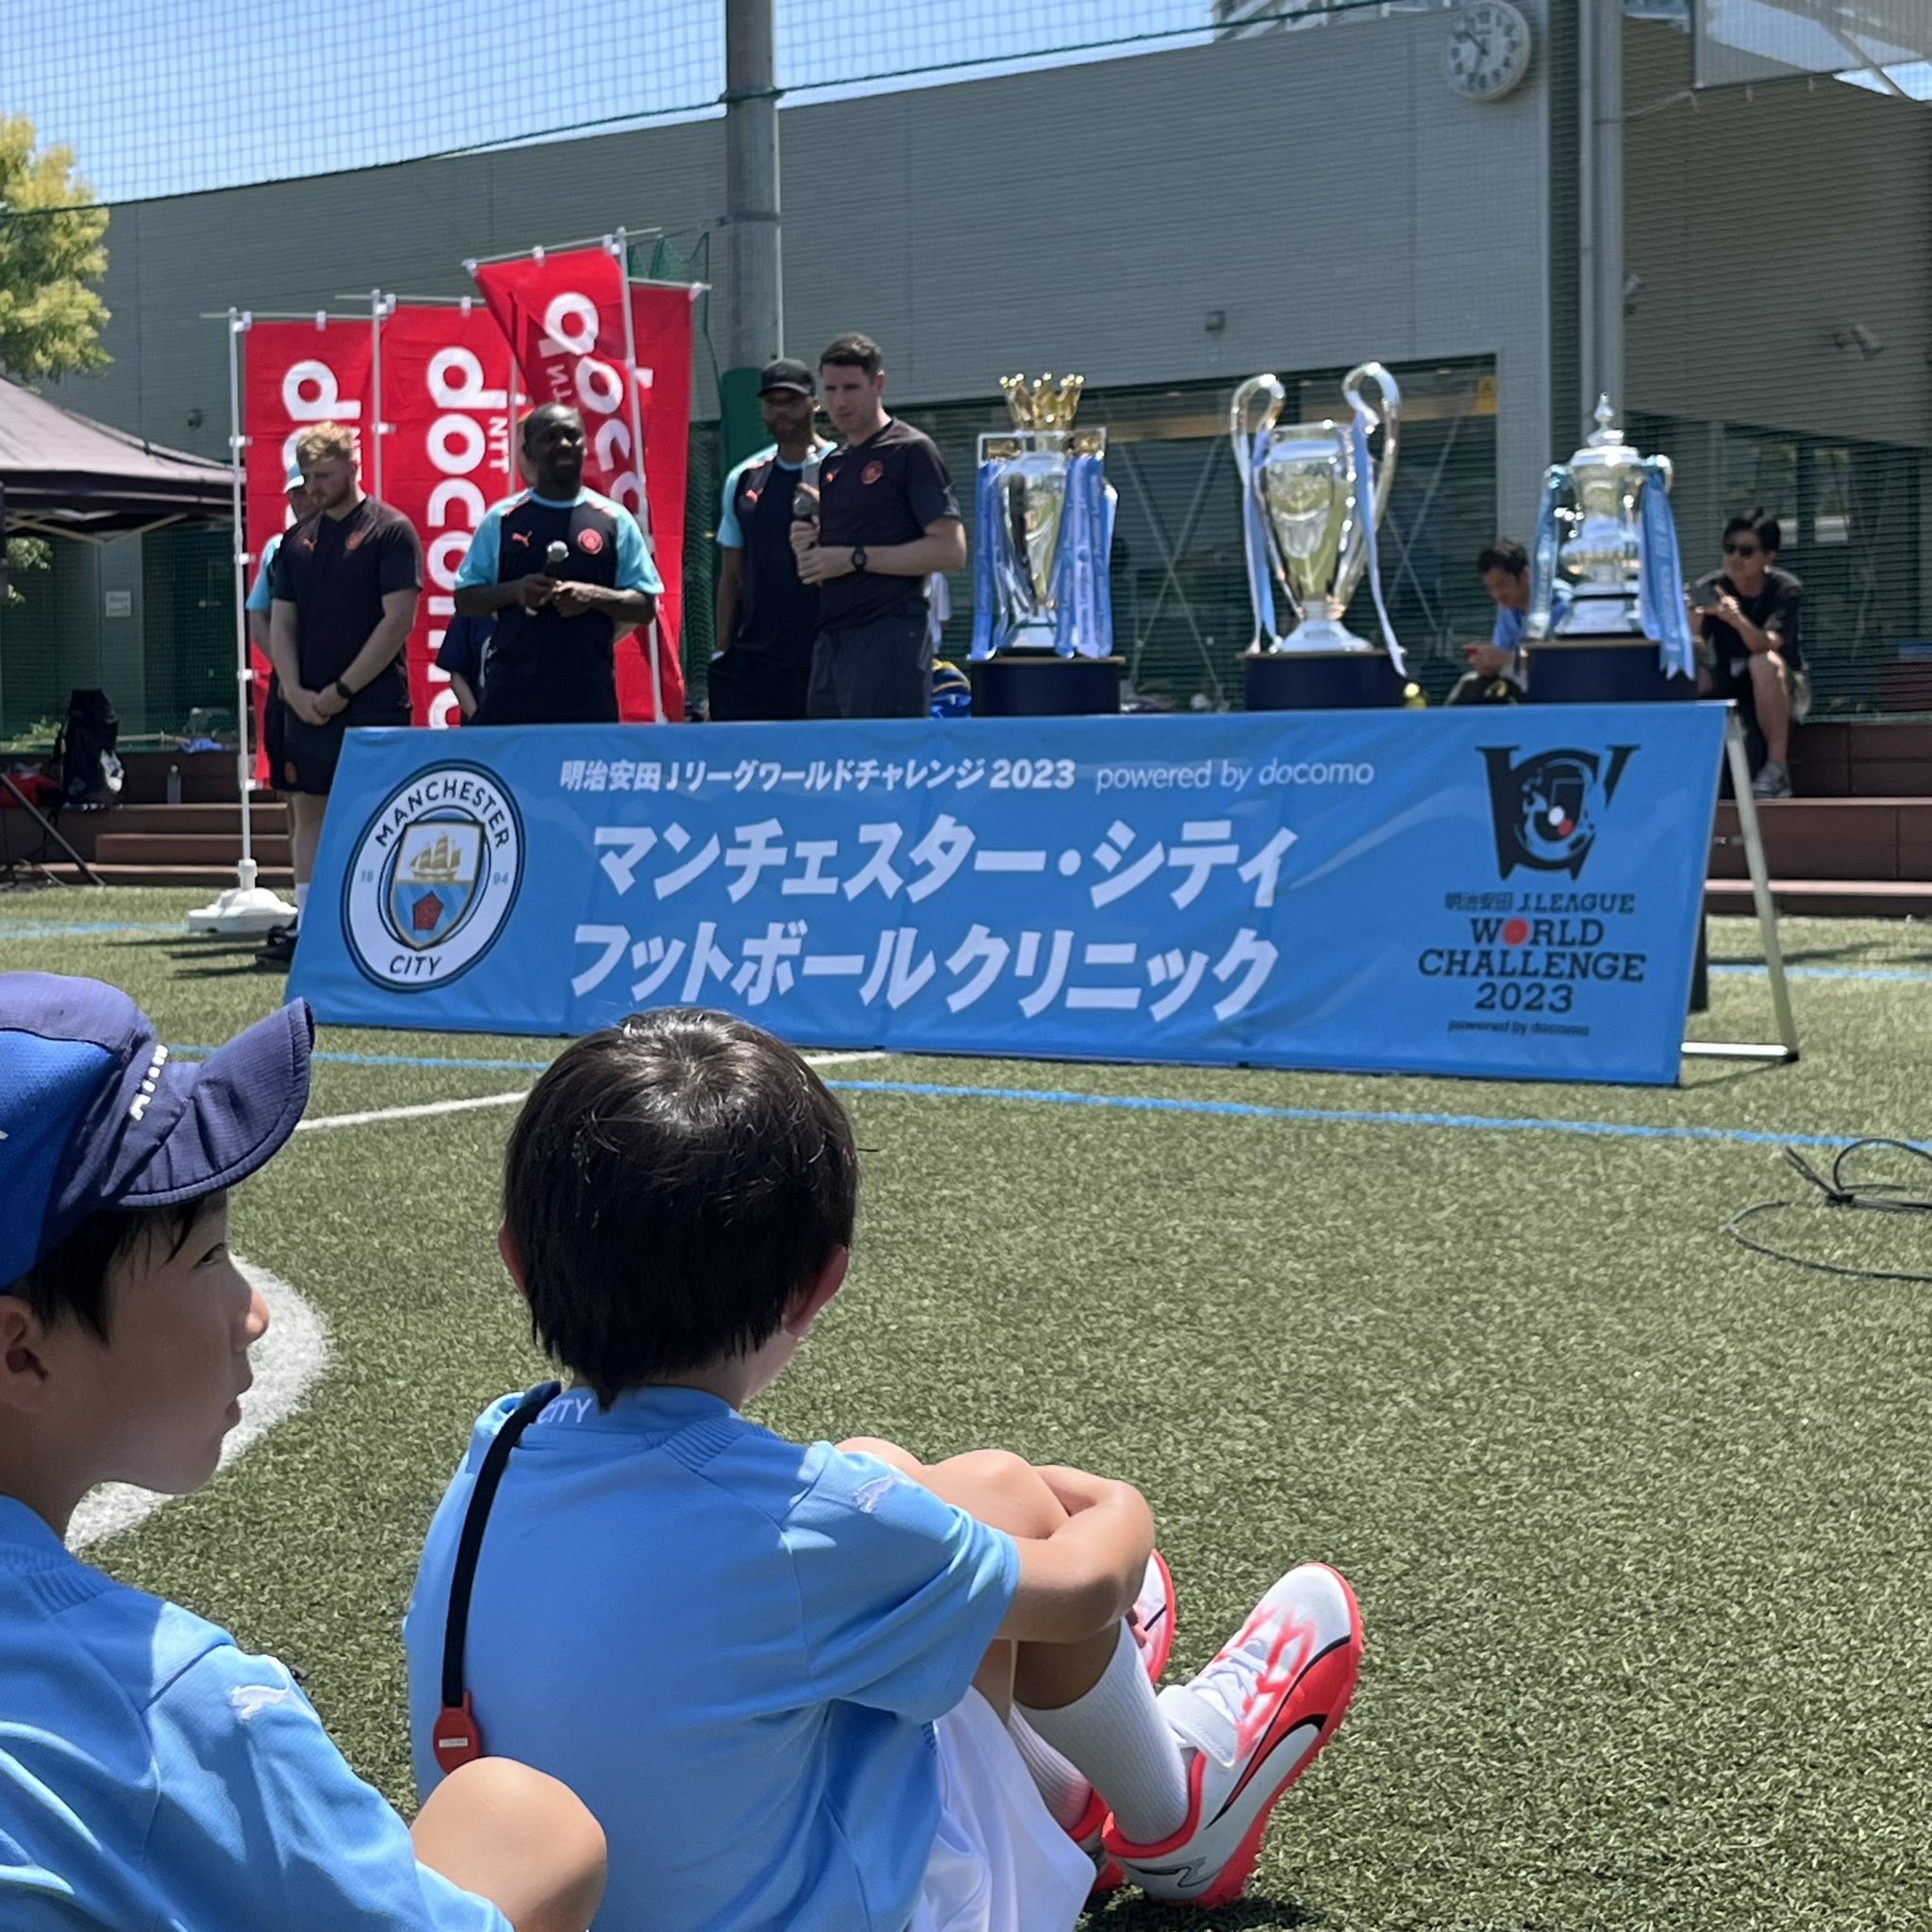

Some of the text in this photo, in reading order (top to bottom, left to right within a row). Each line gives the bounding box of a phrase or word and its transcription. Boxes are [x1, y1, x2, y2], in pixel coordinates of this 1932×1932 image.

[489, 416, 510, 474] NTT
[1095, 758, 1213, 795] powered
[1221, 758, 1254, 793] by
[1258, 758, 1374, 786] docomo
[375, 779, 510, 849] MANCHESTER
[593, 813, 1299, 910] マンチェスター・シティ
[390, 954, 441, 976] CITY
[571, 919, 1279, 1023] フットボールクリニック
[1418, 947, 1647, 983] CHALLENGE
[1474, 982, 1574, 1014] 2023
